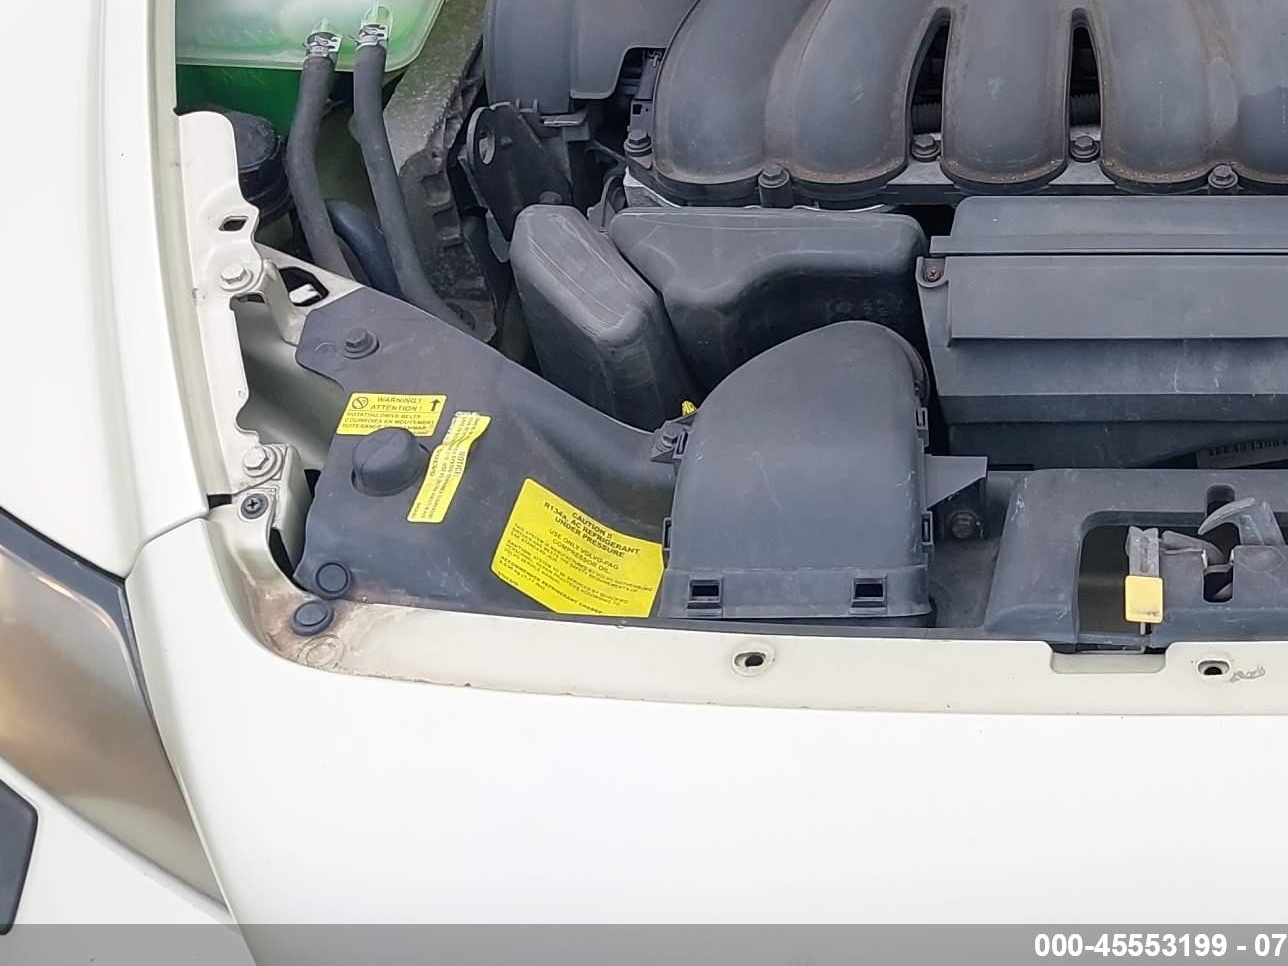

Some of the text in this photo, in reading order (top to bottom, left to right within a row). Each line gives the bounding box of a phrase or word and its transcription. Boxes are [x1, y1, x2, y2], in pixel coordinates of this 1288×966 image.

[555, 517, 625, 558] UNDER PRESSURE
[571, 519, 581, 529] AC
[582, 526, 640, 555] REFRIGERANT
[572, 512, 606, 536] CAUTION
[553, 539, 598, 568] COMPRESSOR
[564, 536, 581, 550] ONLY
